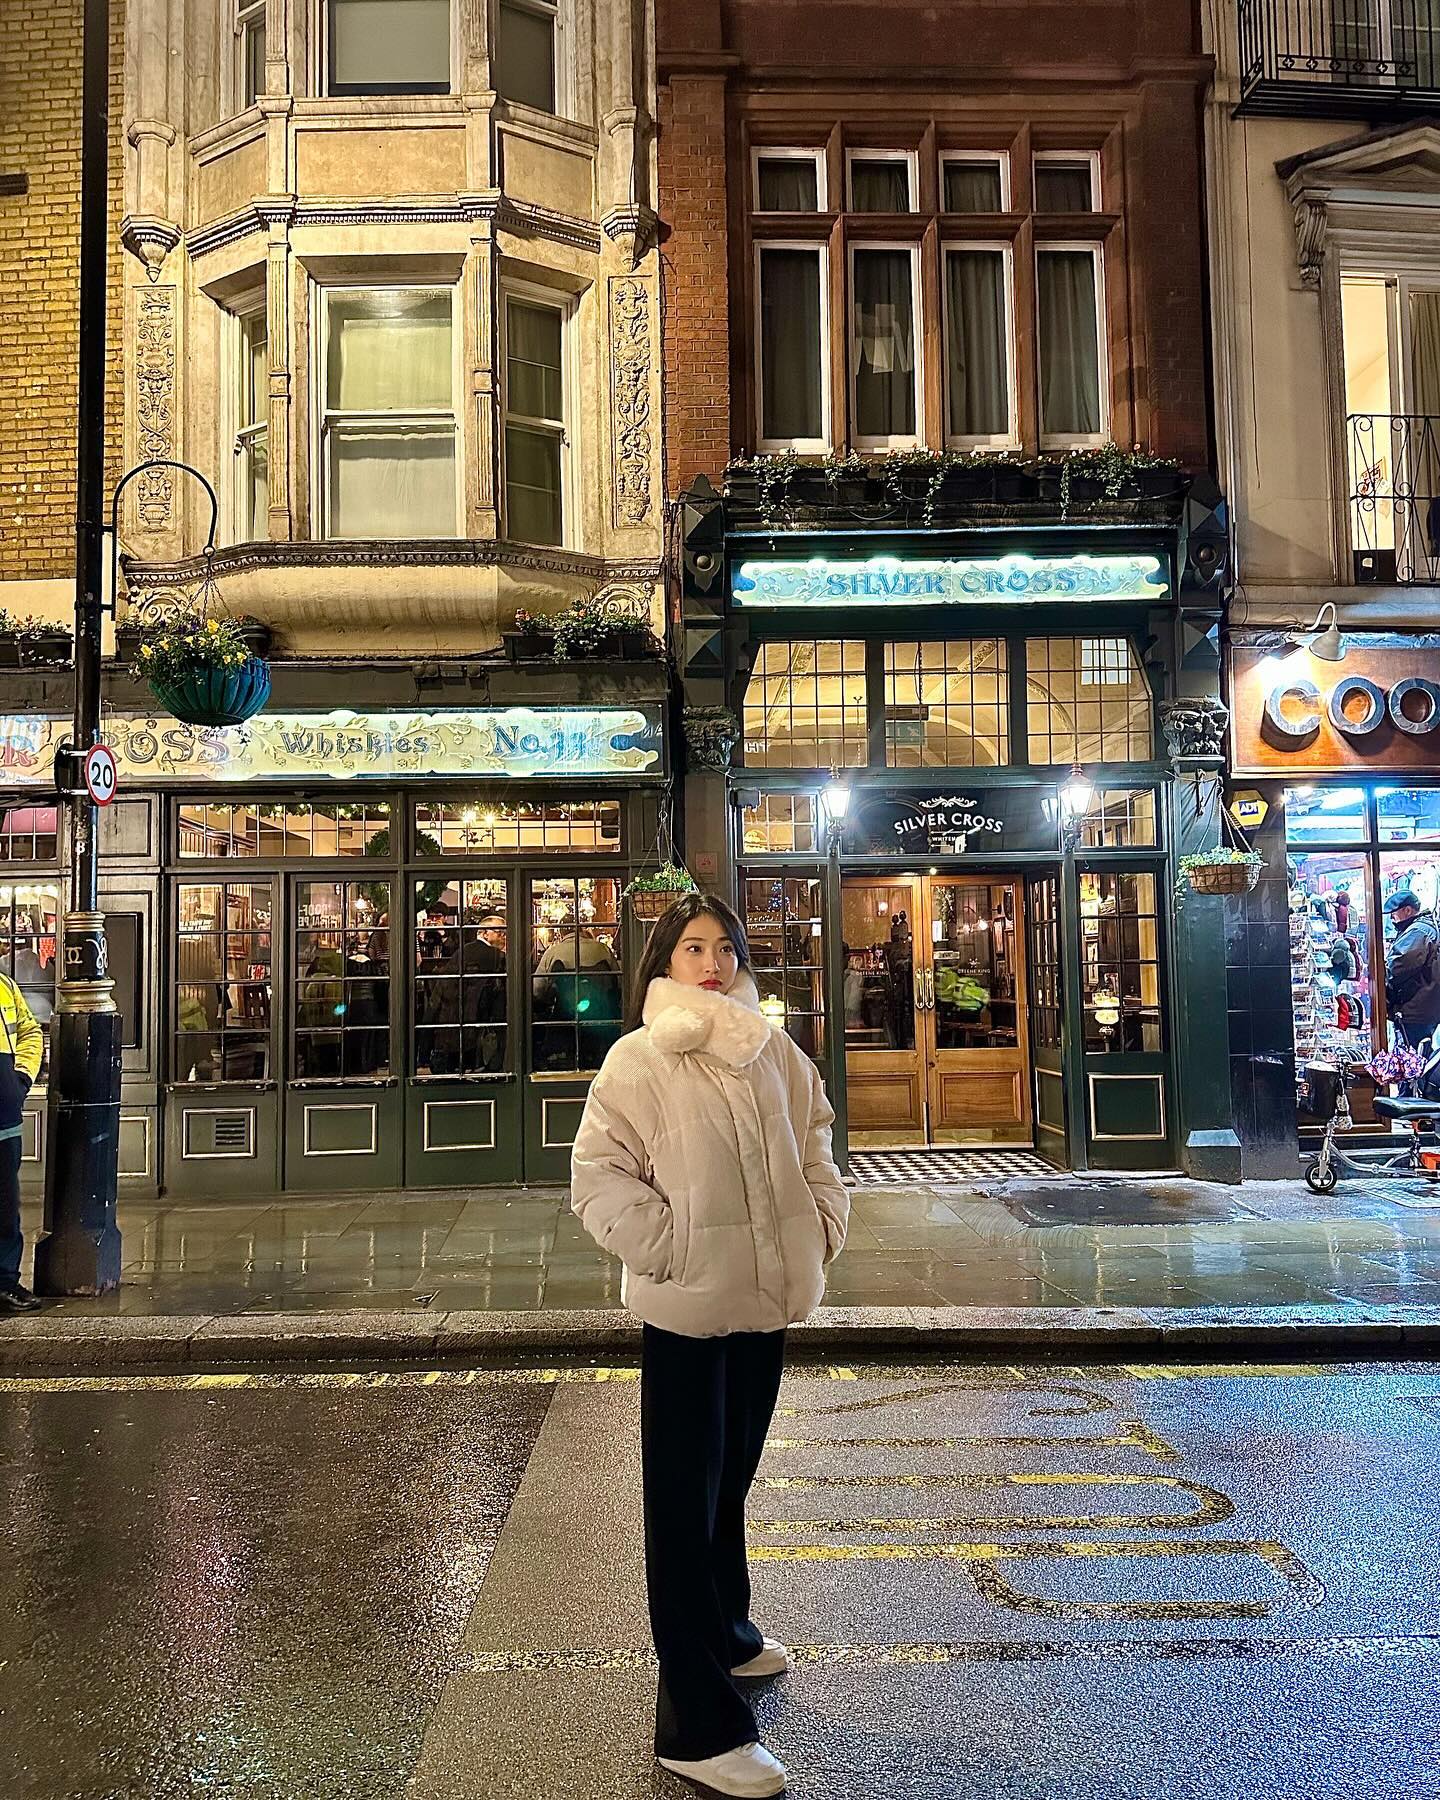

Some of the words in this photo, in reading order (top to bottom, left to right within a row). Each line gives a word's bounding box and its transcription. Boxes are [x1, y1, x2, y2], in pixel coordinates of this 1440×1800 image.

[826, 570, 946, 597] SILVER
[959, 569, 1079, 593] CROSS
[280, 731, 431, 754] Whiskies
[91, 761, 113, 789] 20
[1240, 802, 1259, 814] ADT
[894, 813, 948, 835] SILVER
[951, 813, 1004, 833] CROSS
